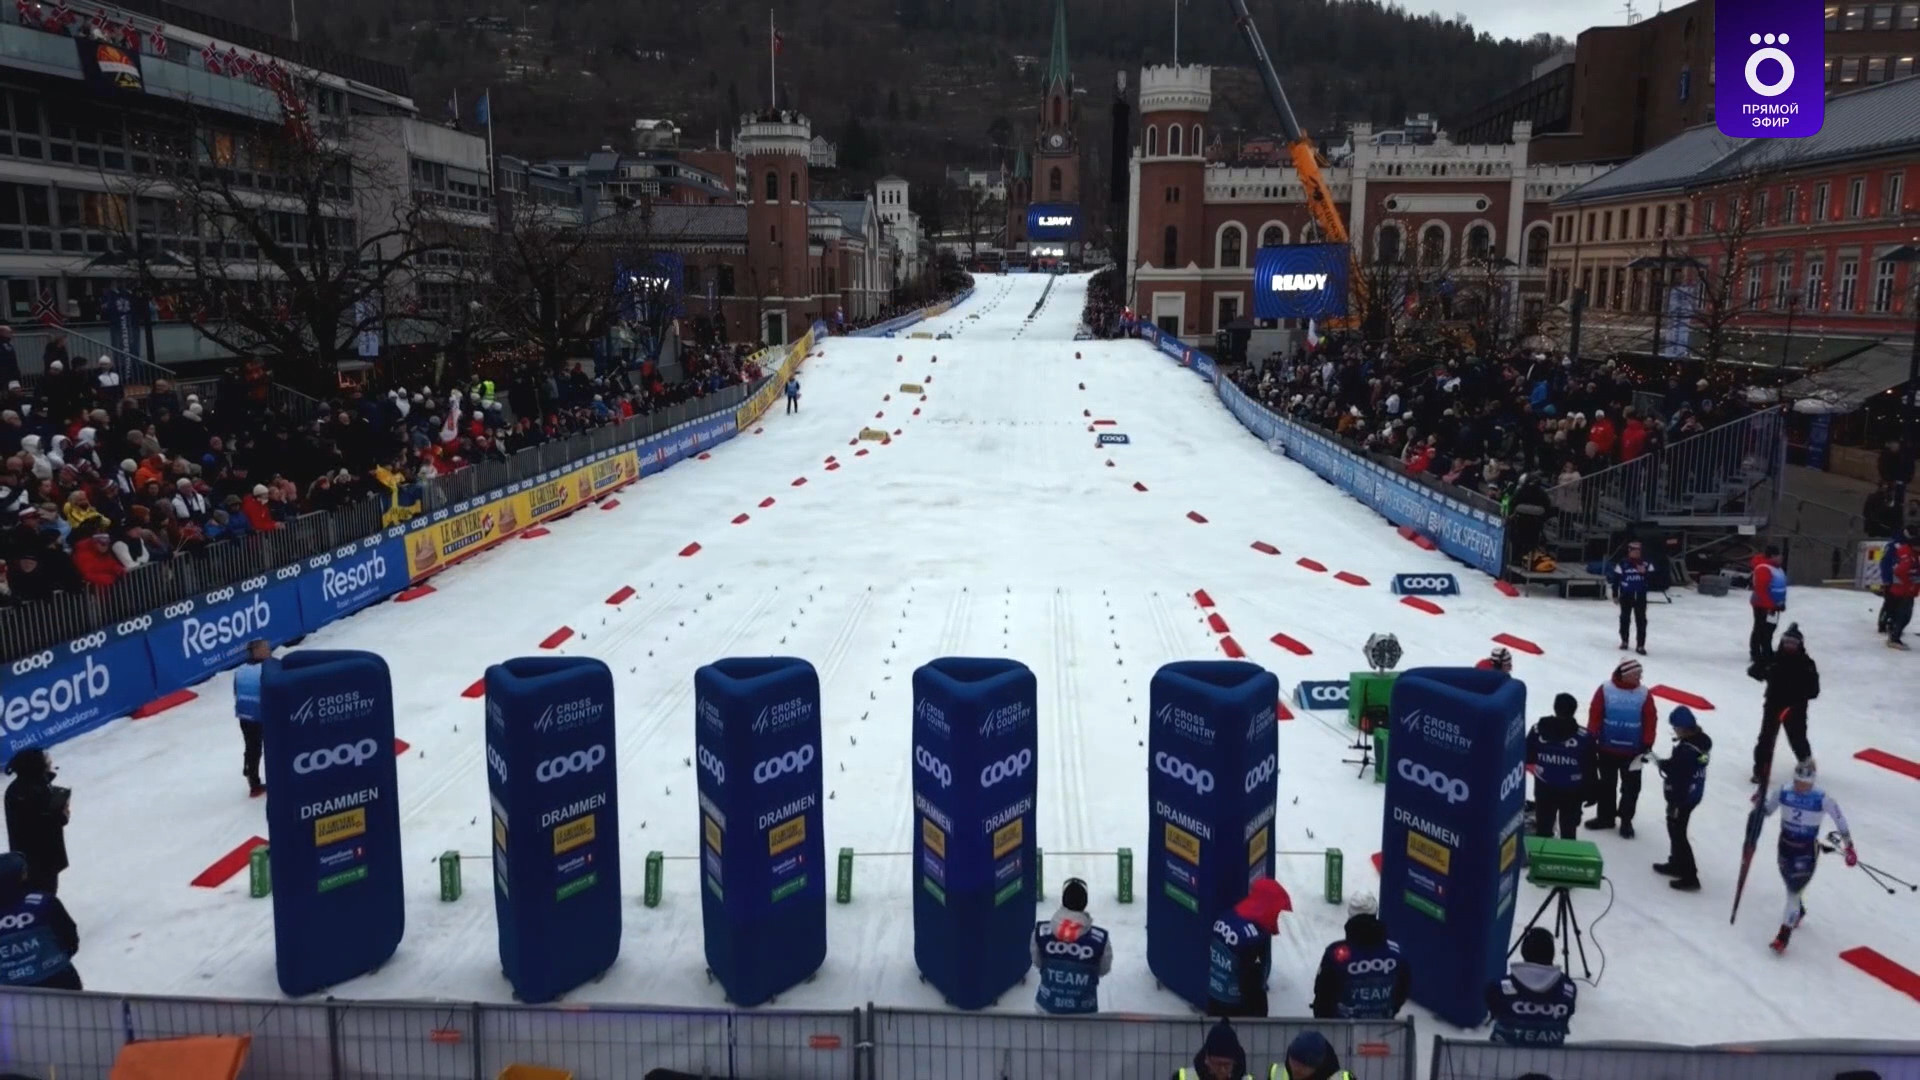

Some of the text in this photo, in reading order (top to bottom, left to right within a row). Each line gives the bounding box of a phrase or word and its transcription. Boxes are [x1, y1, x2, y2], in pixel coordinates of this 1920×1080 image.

[1271, 273, 1328, 291] READY
[472, 495, 486, 507] coop
[490, 489, 503, 500] coop
[433, 508, 448, 521] coop
[454, 501, 469, 513] coop
[388, 524, 406, 539] coop
[411, 516, 428, 529] coop
[337, 543, 357, 559] coop
[364, 533, 382, 548] coop
[309, 551, 332, 569] coop
[277, 563, 301, 580] coop
[323, 549, 386, 602] Resorb
[241, 574, 267, 592] coop
[1403, 577, 1449, 591] coop
[206, 586, 234, 605] coop
[164, 600, 194, 619] coop
[117, 615, 152, 636] coop
[182, 592, 271, 660] Resorb
[70, 631, 107, 654] coop
[12, 650, 54, 676] coop
[318, 690, 360, 707] CROSS
[1311, 686, 1350, 701] coo
[319, 697, 375, 717] COUNTRY
[556, 697, 592, 715] CROSS
[556, 703, 604, 724] COUNTRY
[771, 697, 801, 716] CROSS
[771, 702, 813, 726] COUNTRY
[926, 702, 944, 721] CROSS
[996, 701, 1022, 719] CROSS
[926, 712, 951, 734] COUNTRY
[996, 706, 1032, 729] COUNTRY
[1174, 707, 1205, 727] CROSS
[1423, 714, 1460, 735] CROSS
[1174, 717, 1216, 740] COUNTRY
[1423, 724, 1472, 749] COUNTRY
[293, 738, 378, 775] coop
[536, 744, 605, 782] coop
[699, 744, 725, 786] coop
[753, 744, 815, 784] coop
[916, 745, 952, 789] coop
[980, 748, 1032, 788] coop
[1155, 751, 1215, 795] coop
[1245, 753, 1275, 794] coop
[1397, 758, 1470, 804] coop
[300, 786, 379, 820] DRAMMEN
[541, 792, 606, 828] DRAMMEN
[759, 793, 816, 830] DRAMMEN
[916, 795, 951, 833] DRAMMEN
[985, 797, 1032, 834] DRAMMEN
[1156, 800, 1211, 840] DRAMMEN
[1792, 808, 1802, 821] 2
[1393, 806, 1460, 848] DRAMMEN
[1538, 863, 1584, 873] CERTINA
[1213, 921, 1239, 946] coop
[0, 938, 39, 959] EAM
[1046, 941, 1094, 960] coop
[1347, 958, 1397, 974] coop
[1047, 968, 1090, 986] TEAM
[1511, 1001, 1568, 1019] coop
